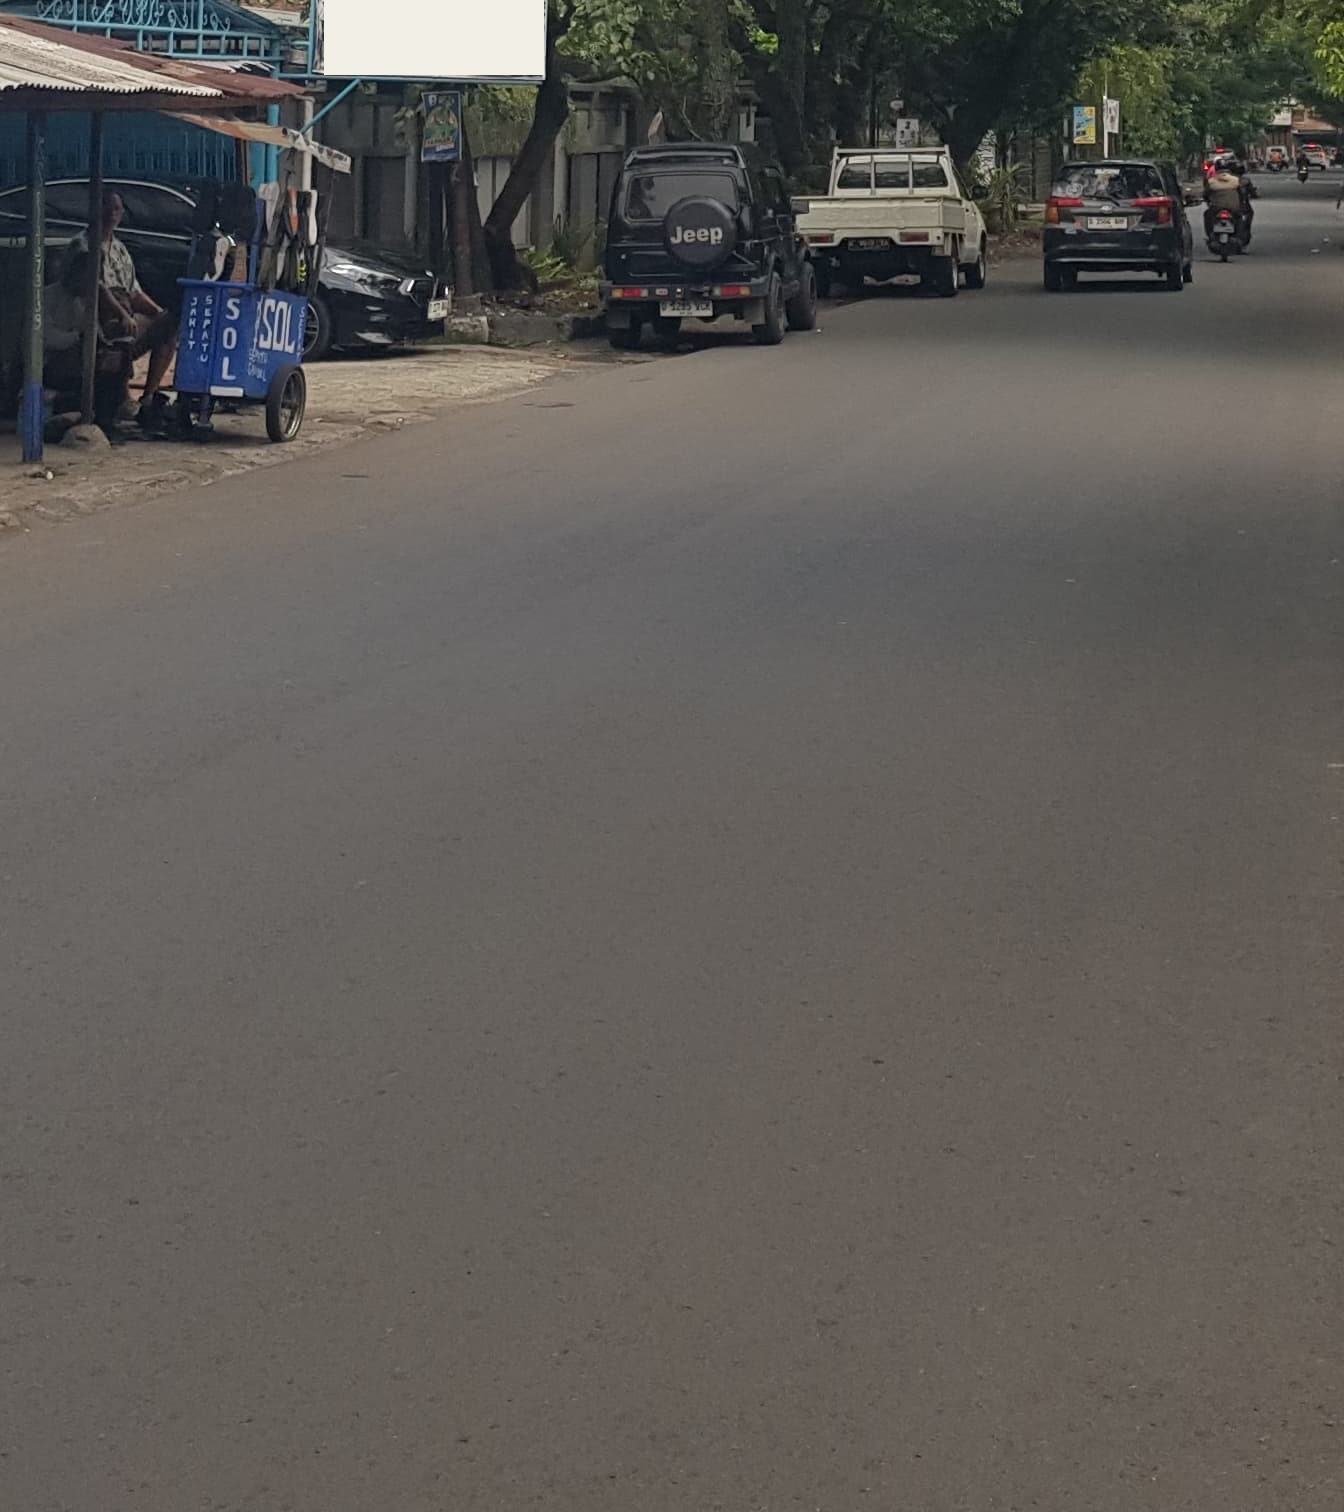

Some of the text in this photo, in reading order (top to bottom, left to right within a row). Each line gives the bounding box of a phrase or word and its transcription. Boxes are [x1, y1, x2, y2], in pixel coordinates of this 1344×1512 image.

[670, 225, 723, 245] Jeep
[200, 295, 213, 362] SEPATU
[222, 298, 240, 380] SOL
[259, 298, 296, 354] SOL
